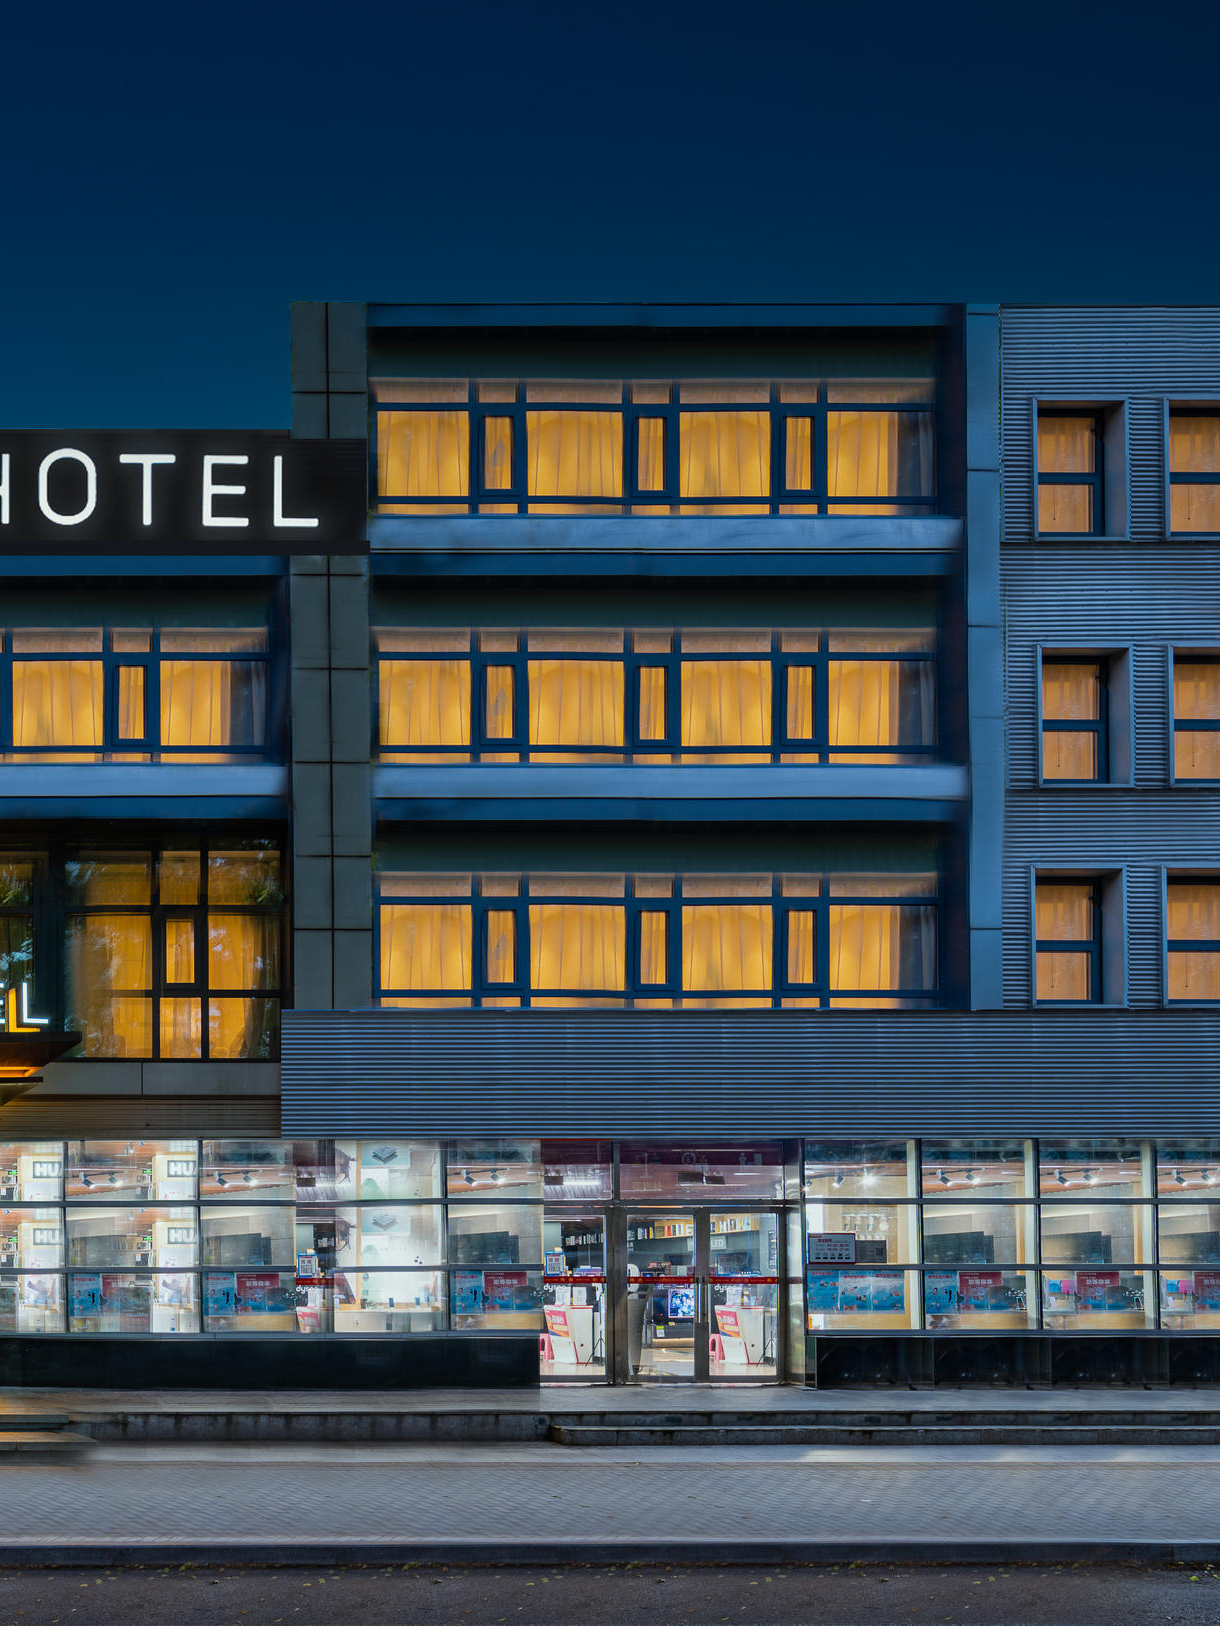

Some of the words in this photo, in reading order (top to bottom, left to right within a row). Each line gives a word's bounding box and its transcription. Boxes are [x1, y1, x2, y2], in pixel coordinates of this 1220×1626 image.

[34, 1162, 62, 1177] HU
[169, 1161, 196, 1176] HU
[34, 1229, 62, 1243] HU
[169, 1228, 196, 1242] HU
